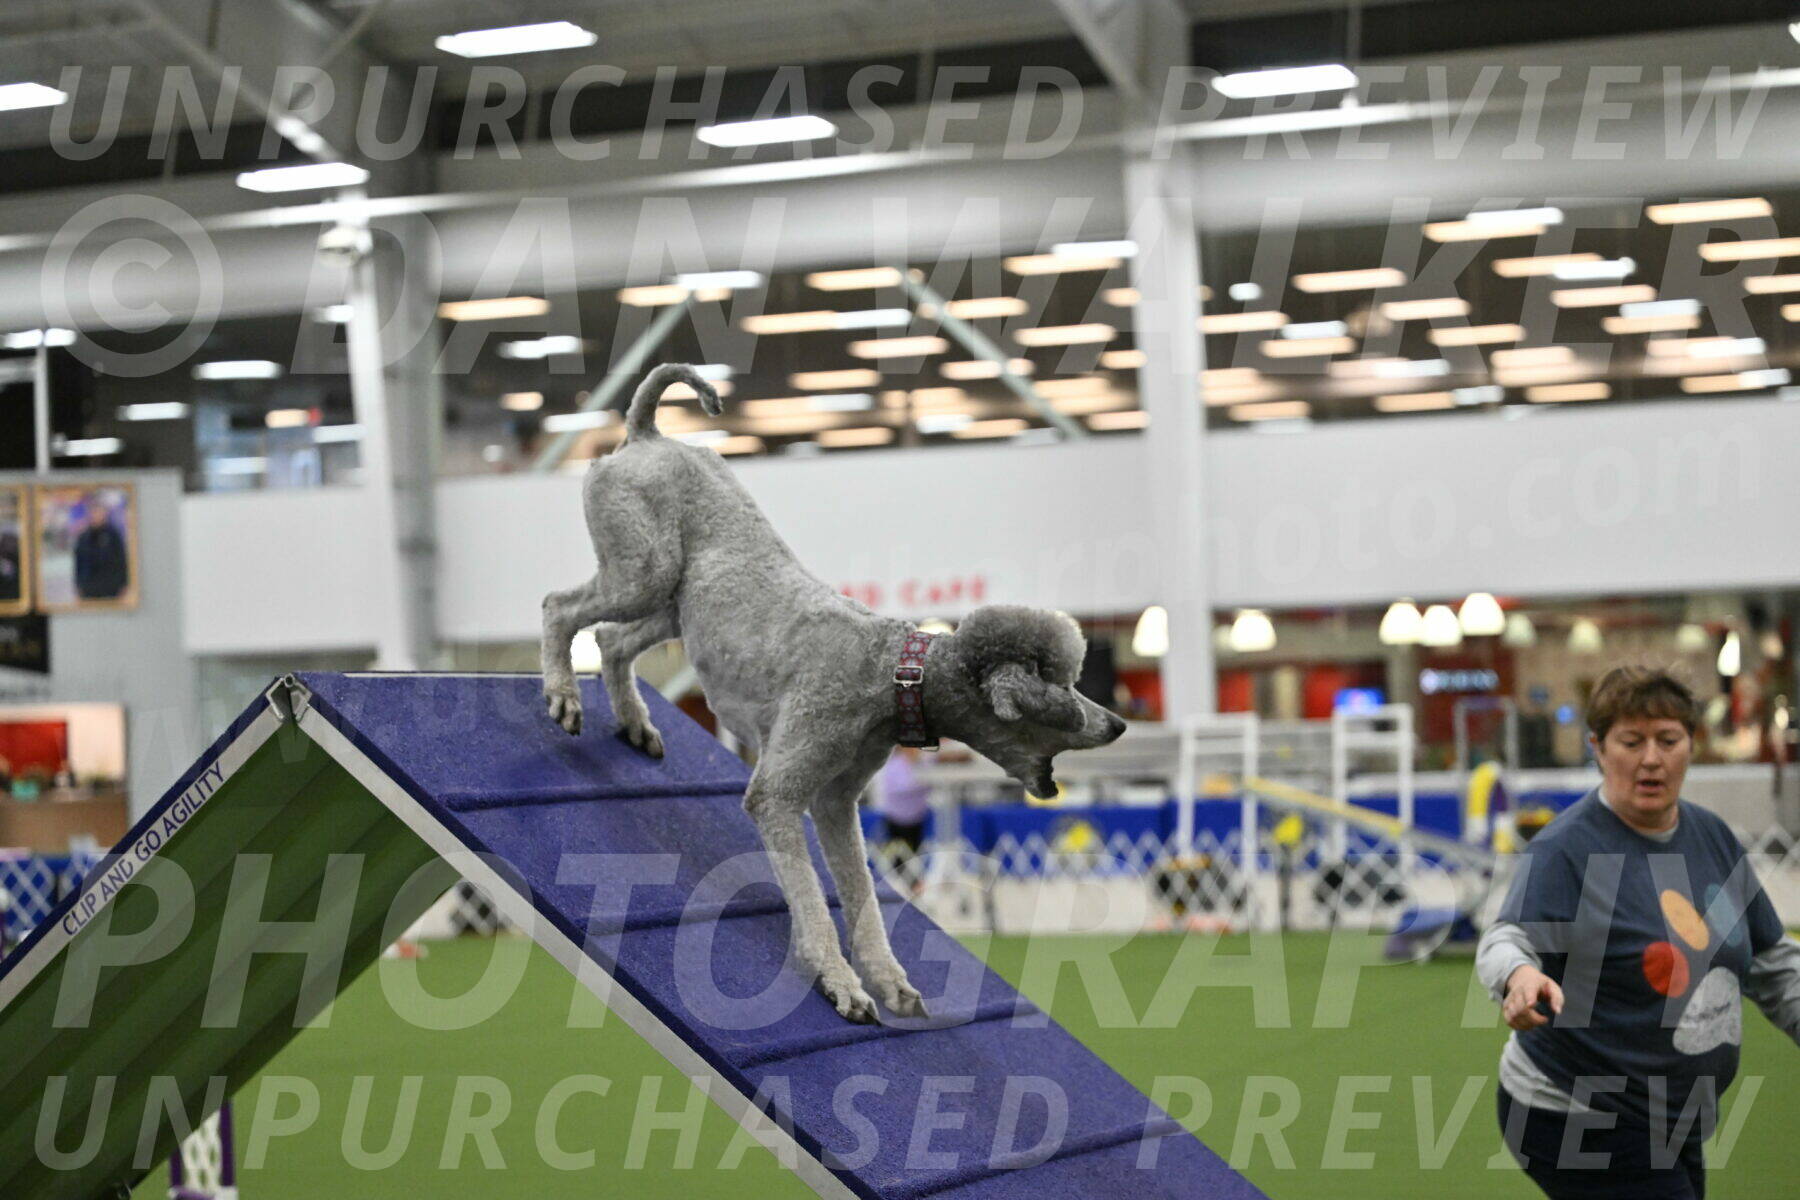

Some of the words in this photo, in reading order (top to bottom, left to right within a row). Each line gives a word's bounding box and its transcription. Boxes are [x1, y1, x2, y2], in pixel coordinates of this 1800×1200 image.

[62, 892, 97, 936] CLIP
[100, 859, 134, 902] AND
[134, 830, 161, 862] GO
[162, 762, 225, 837] AGILITY
